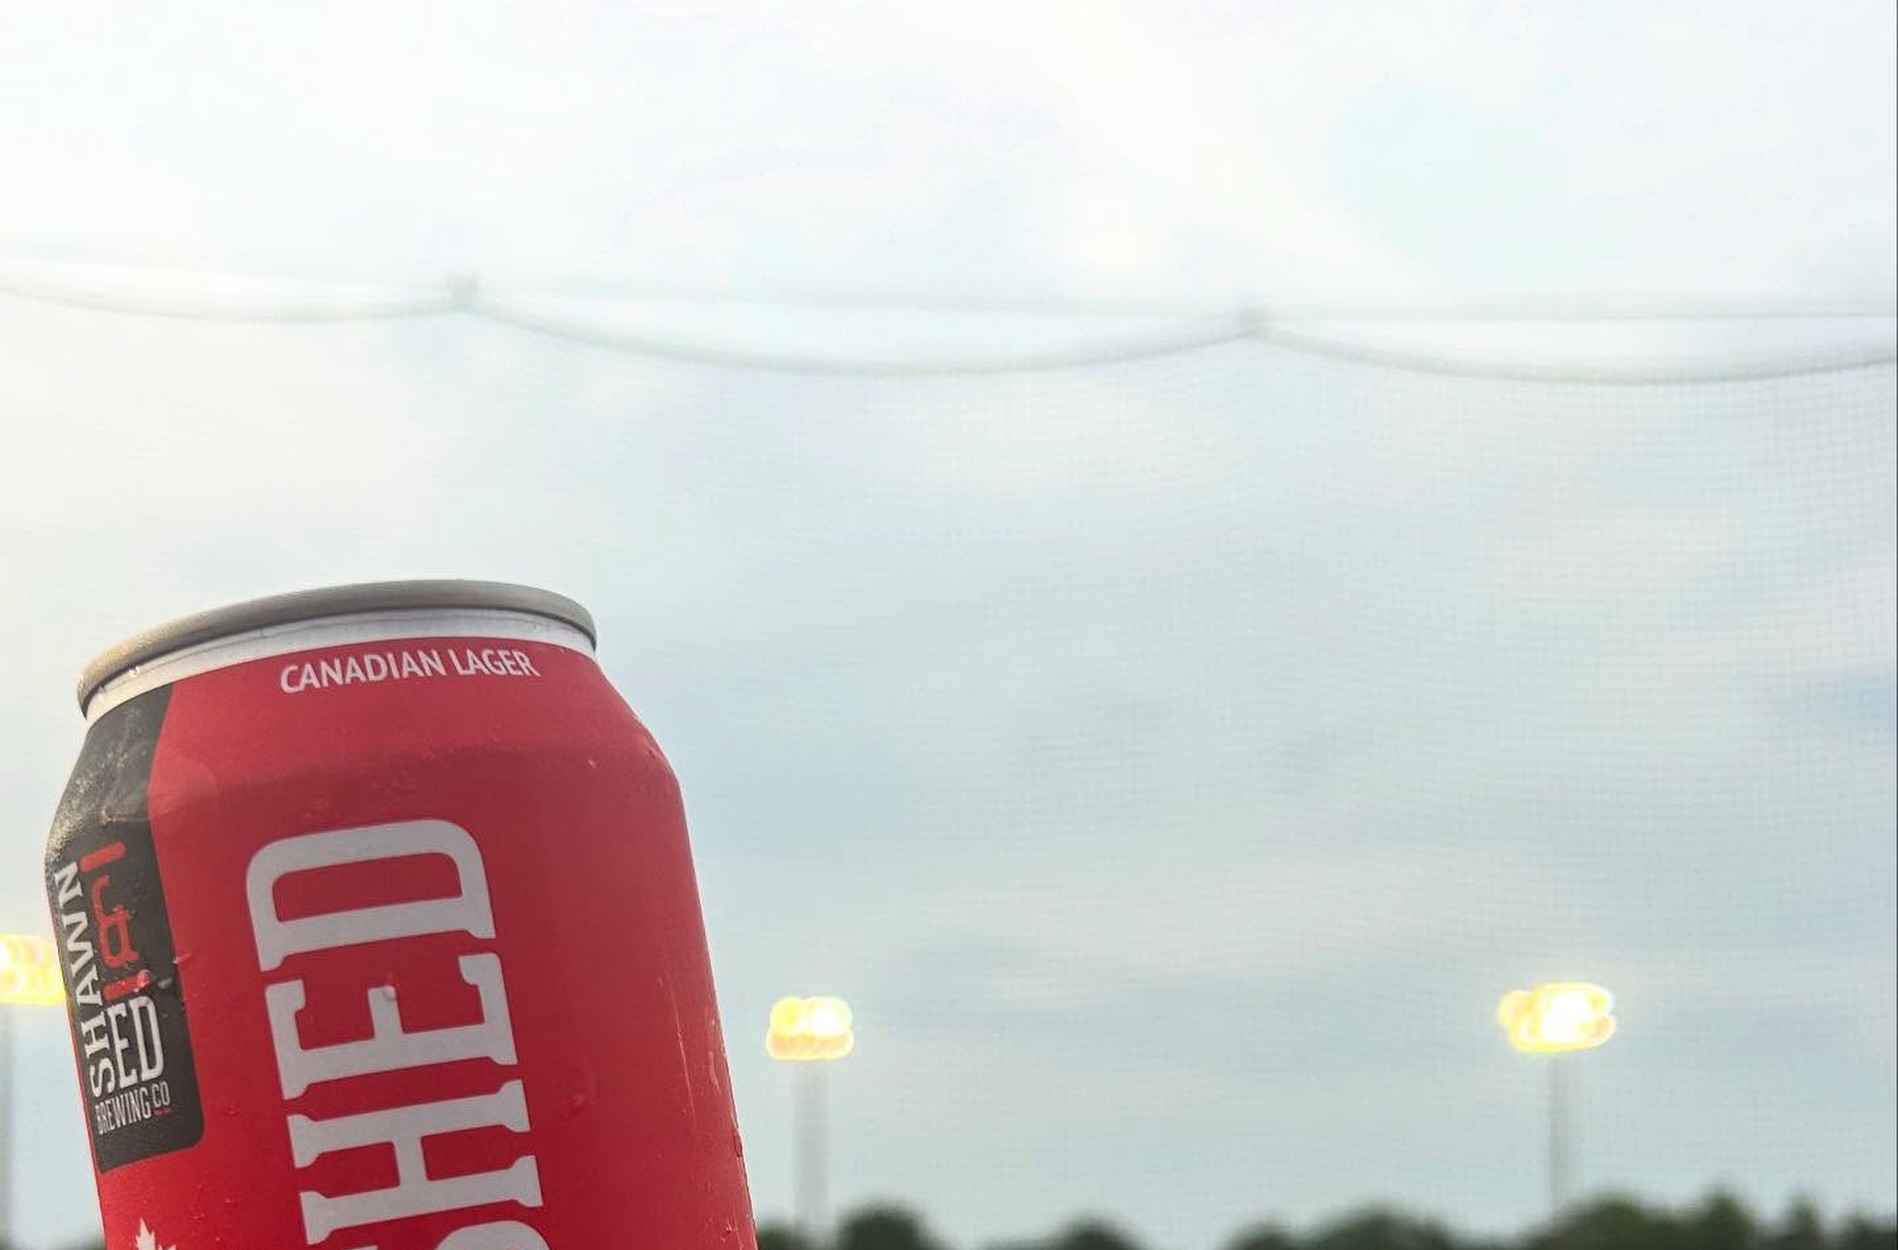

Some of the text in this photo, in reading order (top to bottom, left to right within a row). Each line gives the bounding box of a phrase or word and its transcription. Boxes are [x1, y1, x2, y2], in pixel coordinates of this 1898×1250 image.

[280, 648, 541, 694] CANADIAN LAGER
[53, 861, 115, 1098] SHAWN
[95, 1080, 171, 1135] BREWING CO
